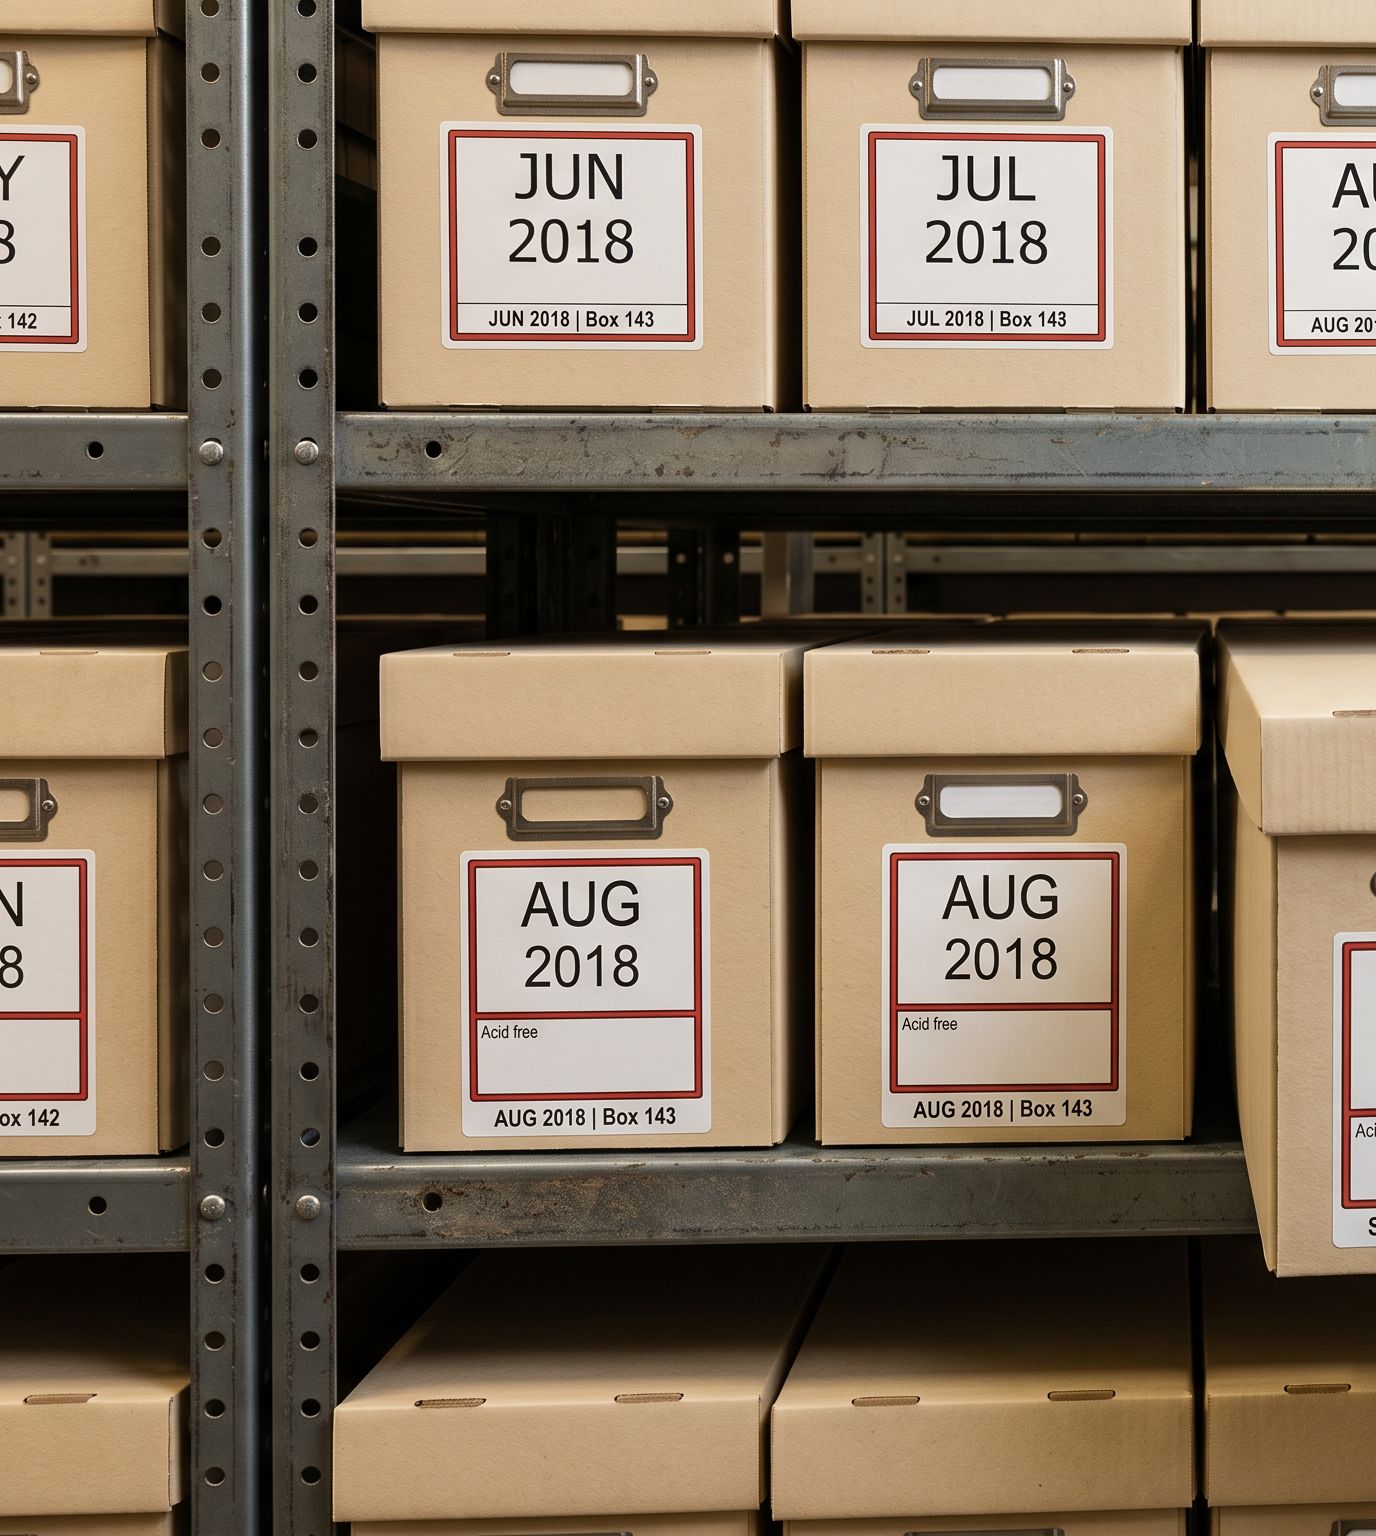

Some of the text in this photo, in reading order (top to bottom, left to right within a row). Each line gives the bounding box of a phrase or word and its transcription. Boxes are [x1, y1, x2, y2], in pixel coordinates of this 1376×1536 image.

[515, 153, 622, 200] JUN
[937, 155, 1035, 201] JUL
[510, 219, 633, 263] 2018
[926, 220, 1047, 264] 2018
[8, 313, 37, 329] 142
[489, 311, 524, 328] JUN
[530, 311, 570, 328] 2018
[586, 311, 618, 328] Box
[625, 311, 654, 328] 143
[907, 310, 939, 326] JUL
[945, 311, 983, 326] 2018
[1001, 311, 1031, 327] Box
[1039, 311, 1066, 327] 143
[1311, 317, 1348, 332] AUG
[521, 880, 639, 927] AUG
[942, 874, 1057, 919] AUG
[525, 945, 638, 987] 2018
[945, 938, 1057, 980] 2018
[481, 1025, 537, 1038] Acid free
[902, 1017, 957, 1030] Acid free
[28, 1109, 59, 1126] 142
[494, 1109, 536, 1127] AUG
[543, 1109, 585, 1126] 2018
[604, 1108, 638, 1125] Box
[645, 1107, 675, 1124] 143
[913, 1101, 955, 1118] AUG
[961, 1100, 1003, 1118] 2018
[1021, 1100, 1055, 1117] Box
[1062, 1099, 1092, 1116] 143
